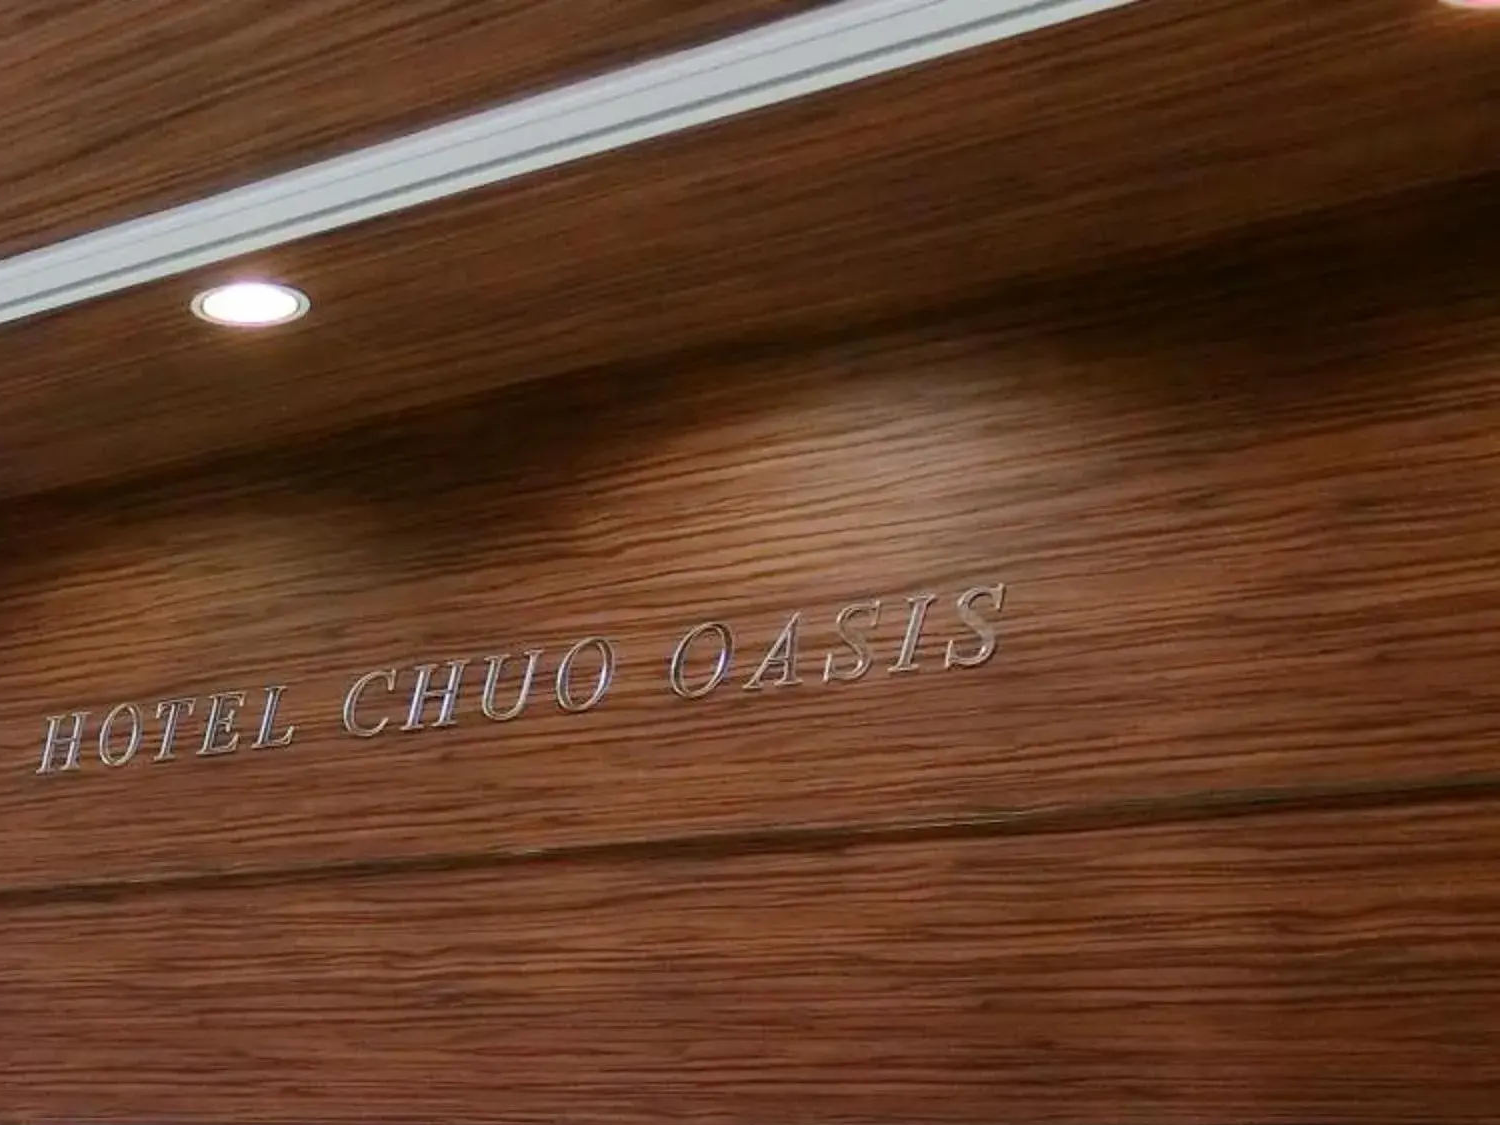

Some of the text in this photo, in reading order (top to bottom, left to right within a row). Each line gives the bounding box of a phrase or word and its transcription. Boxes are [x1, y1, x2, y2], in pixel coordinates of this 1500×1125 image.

[36, 583, 1008, 775] HOTEL CHUO OASIS
